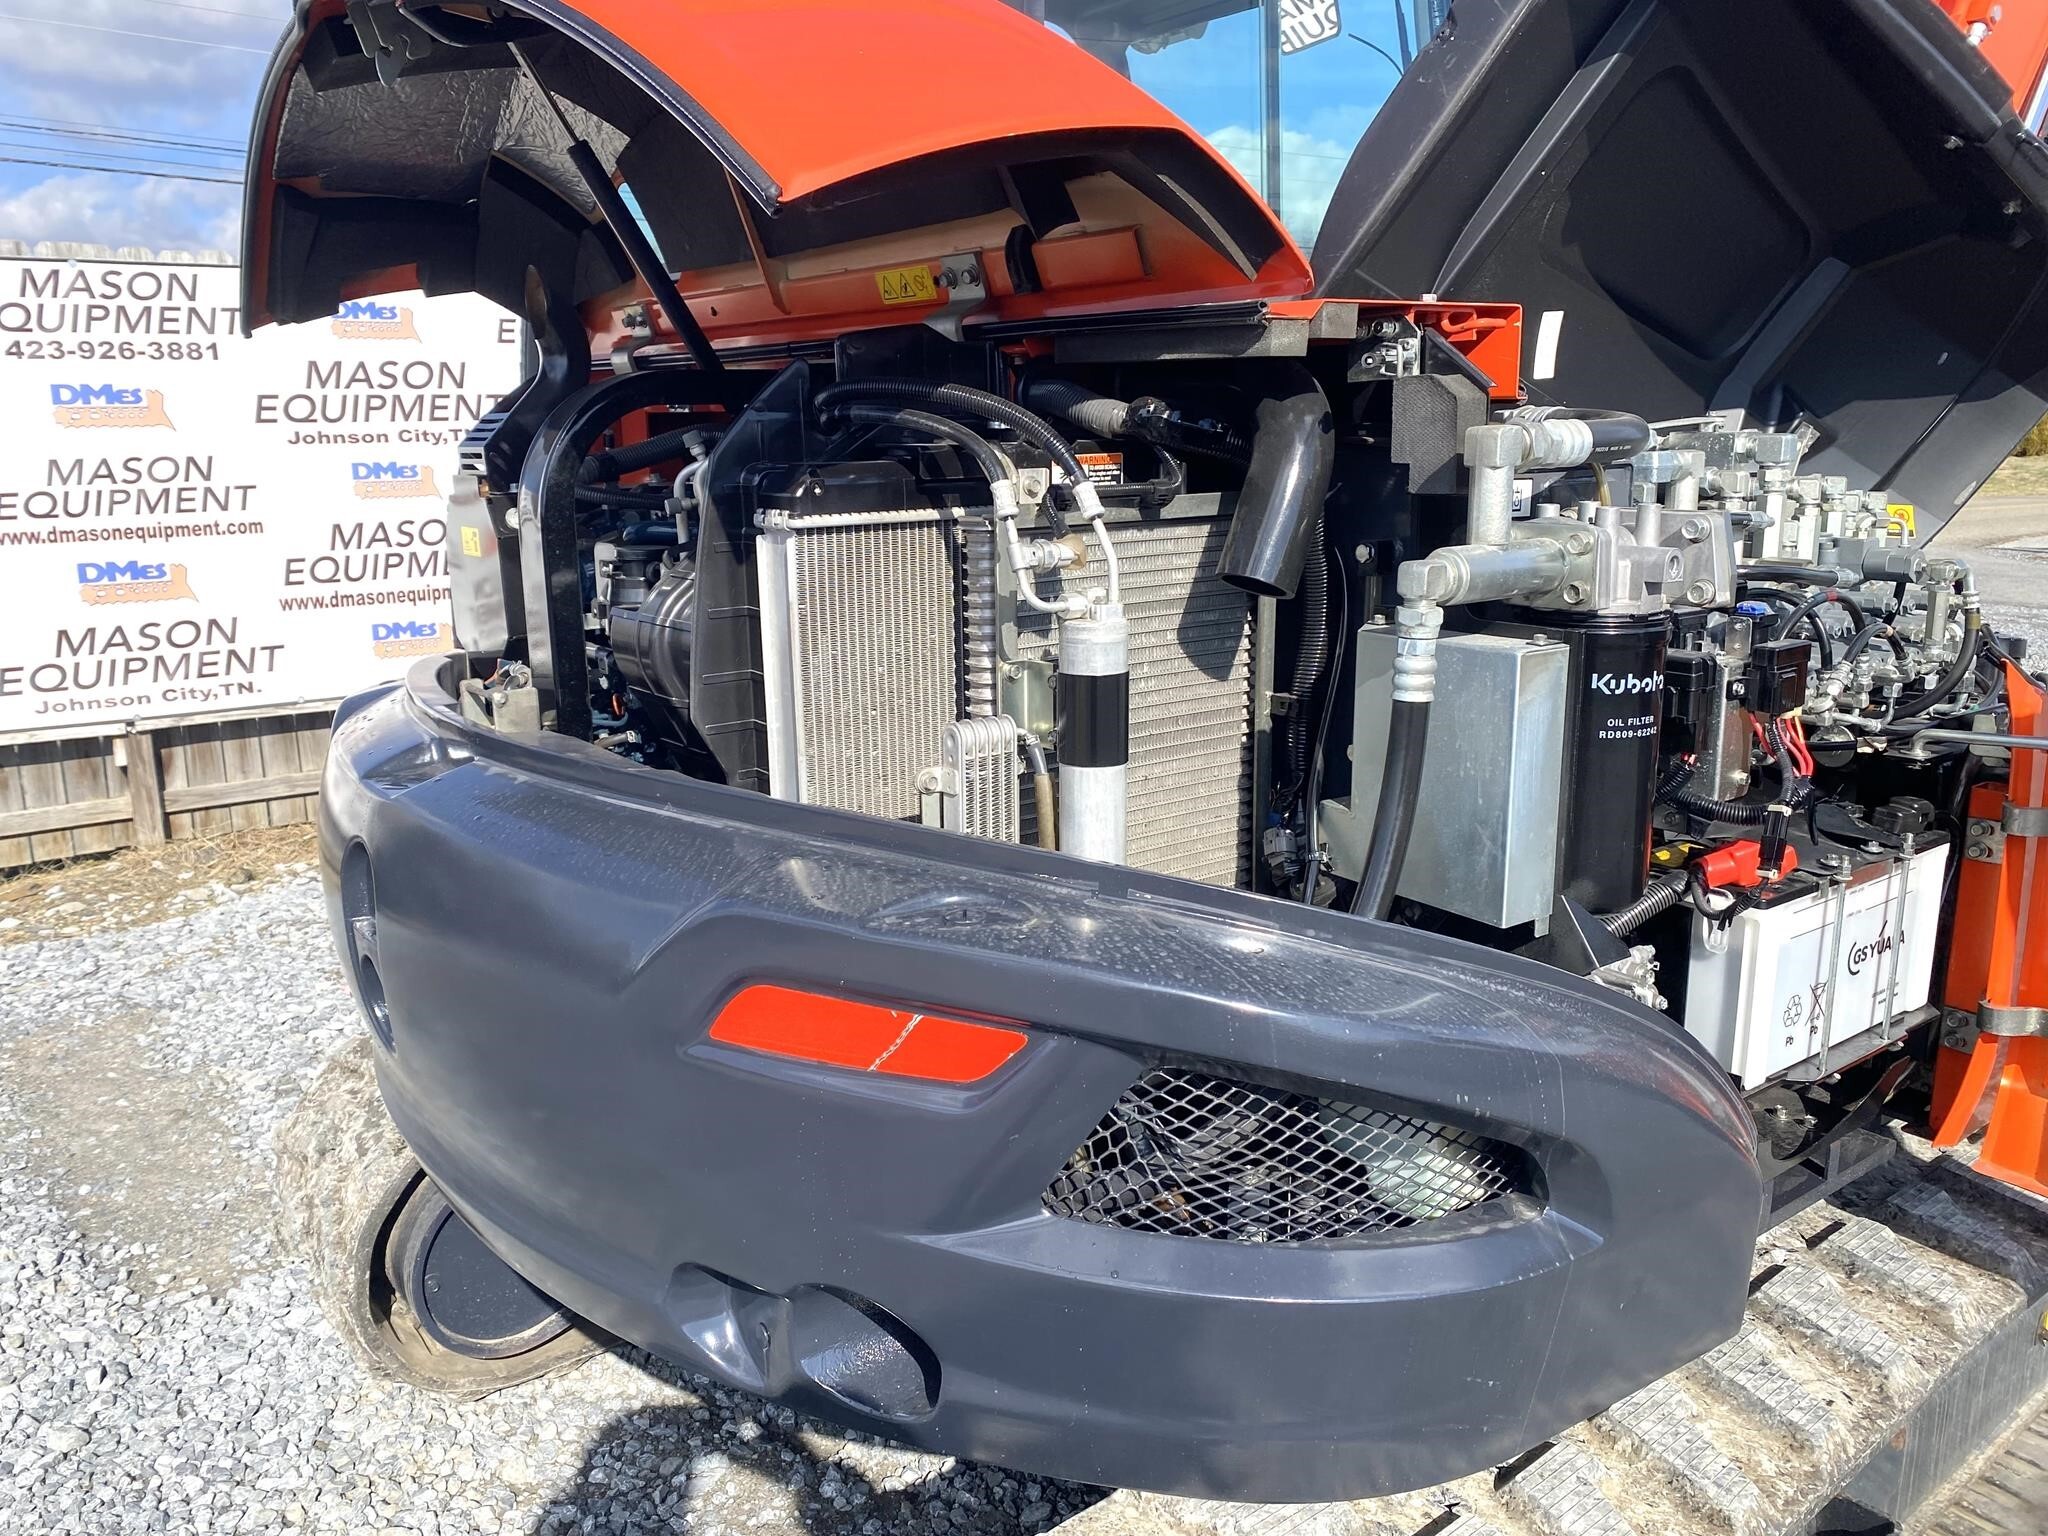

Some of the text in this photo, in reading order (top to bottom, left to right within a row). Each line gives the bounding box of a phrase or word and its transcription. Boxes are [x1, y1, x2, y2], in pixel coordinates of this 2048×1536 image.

[19, 267, 198, 301] MASON
[5, 340, 219, 361] 423-926-3881
[305, 360, 466, 390] MASON
[287, 431, 390, 445] Johnson
[47, 455, 213, 487] MASON
[0, 485, 257, 520] EQUIPMENT
[55, 616, 238, 658] MASON
[0, 644, 285, 697] EQUIPMENT
[34, 680, 262, 715] Johnson City,TN.
[1607, 715, 1654, 727] OIL FILTER
